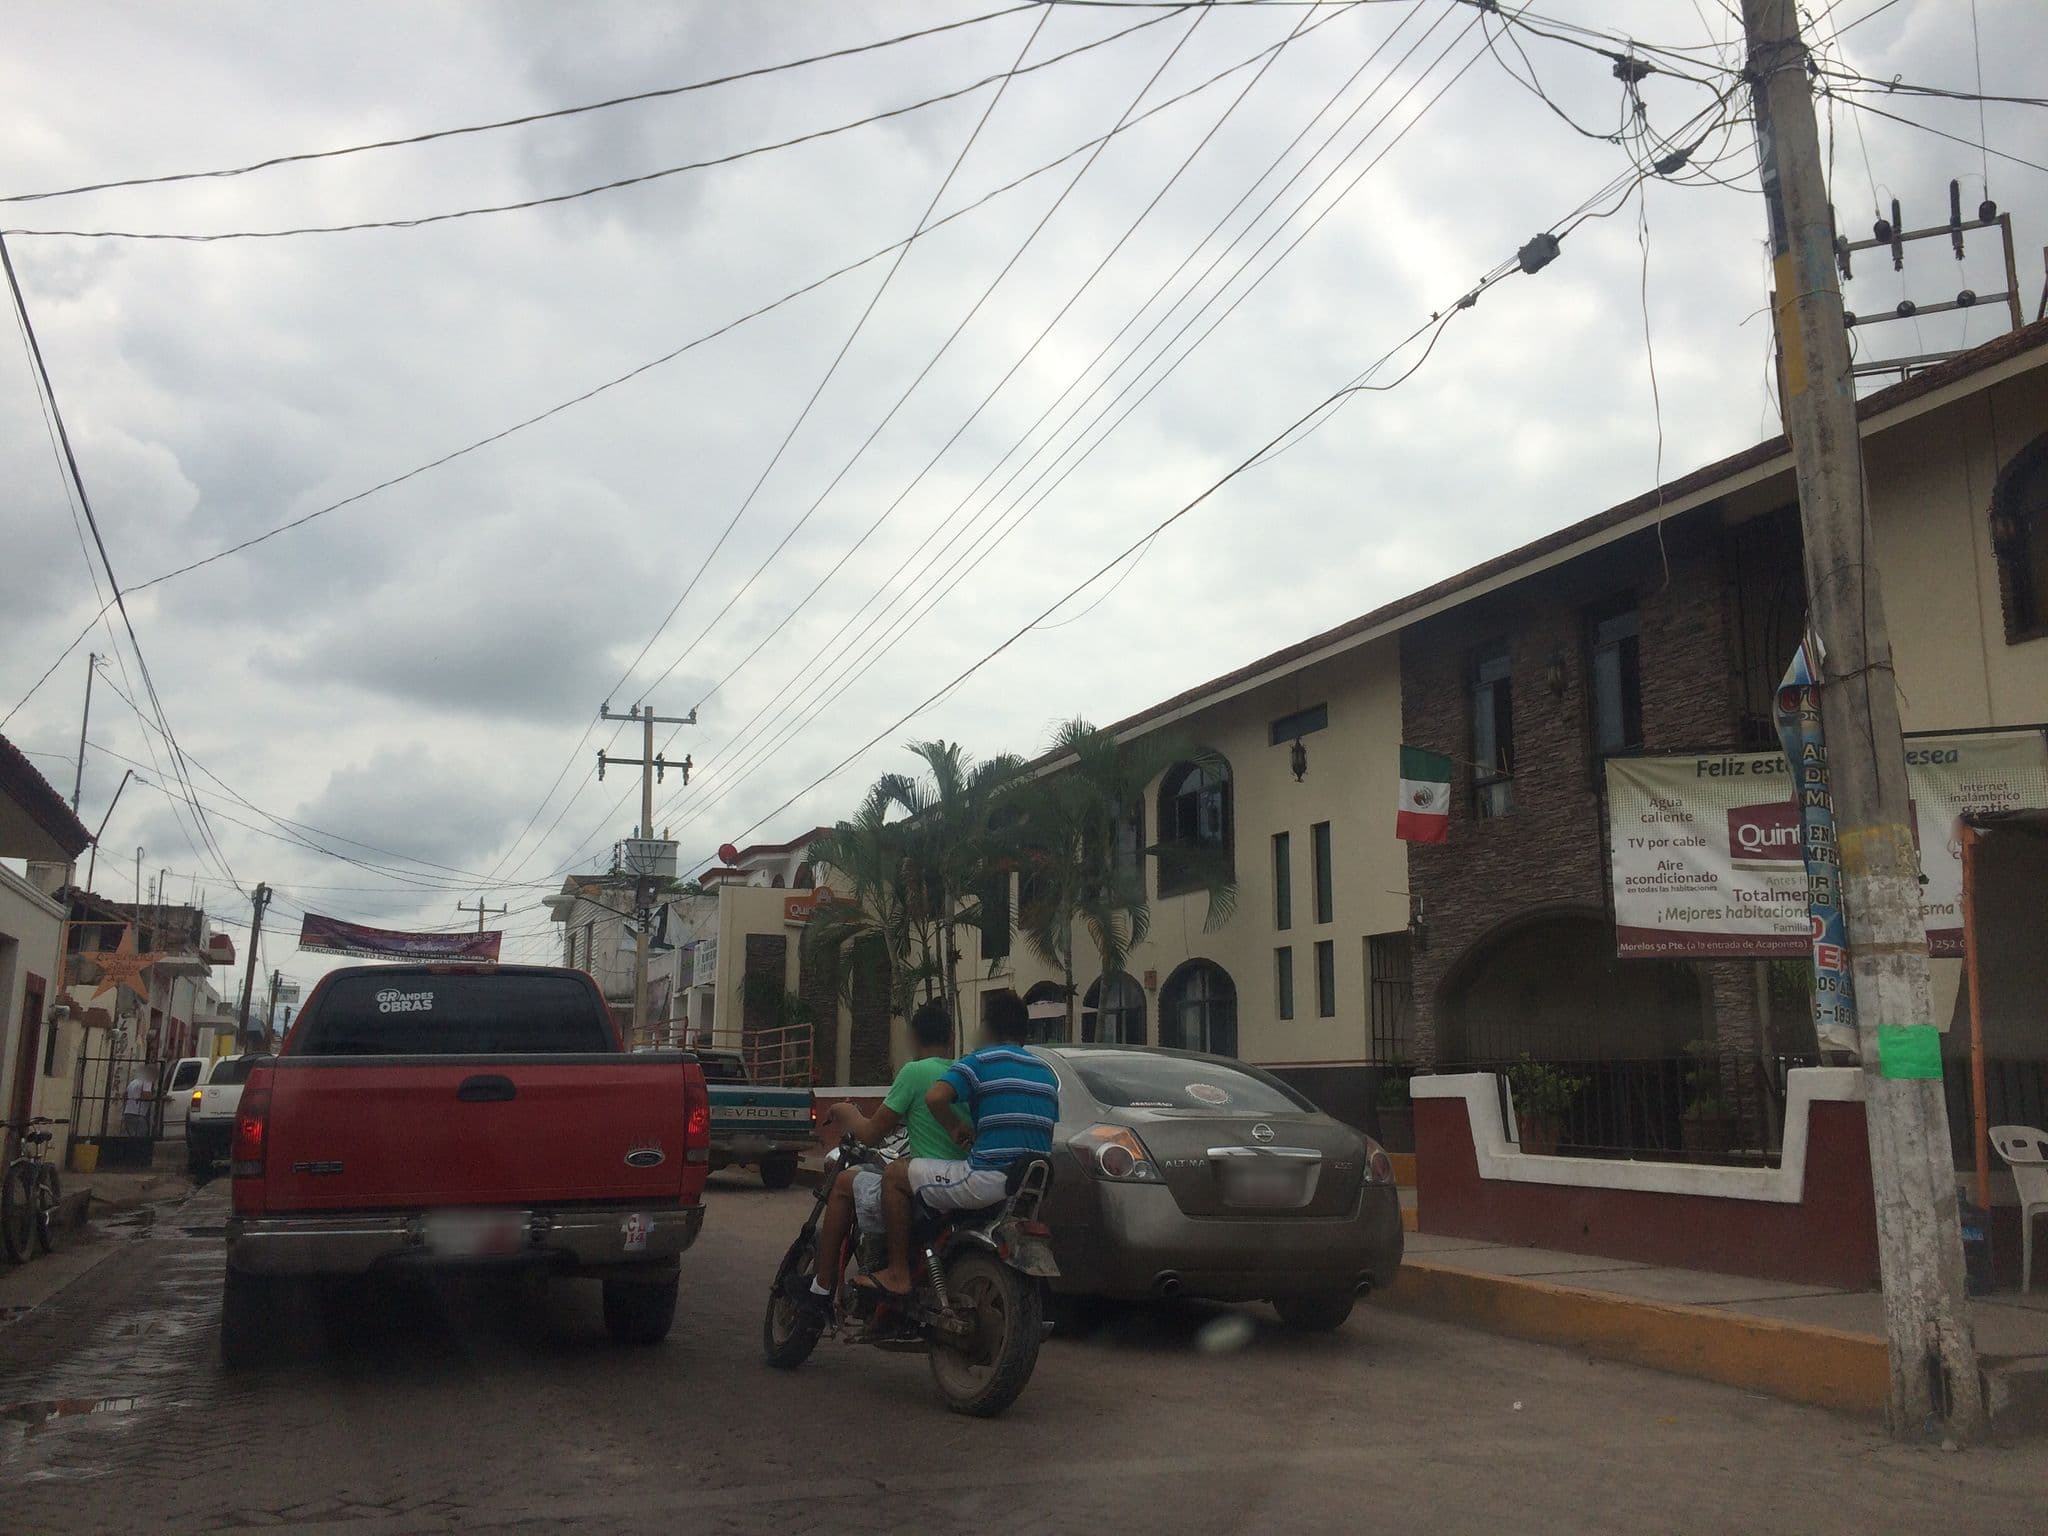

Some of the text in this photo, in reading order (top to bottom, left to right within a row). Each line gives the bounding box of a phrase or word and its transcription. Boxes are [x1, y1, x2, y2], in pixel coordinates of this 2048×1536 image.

[1905, 749, 1958, 765] esea
[1696, 758, 1745, 777] Feliz
[1960, 782, 2008, 792] Internet
[1950, 791, 2020, 803] inalámbrico
[1649, 798, 1682, 811] Agua
[1641, 812, 1694, 823] caliente
[1628, 837, 1706, 850] TV por cable
[1657, 860, 1683, 871] Aire
[1625, 871, 1718, 885] acondicionado
[1638, 885, 1658, 893] todas
[1671, 884, 1718, 892] habitaciones
[1620, 942, 1654, 951] Morelos
[1707, 941, 1740, 950] entrada
[1743, 941, 1754, 949] de
[1936, 940, 1955, 950] 252
[376, 990, 434, 1002] GRANDES
[379, 1000, 432, 1013] OBRAS
[1165, 1159, 1205, 1168] ALTIMA
